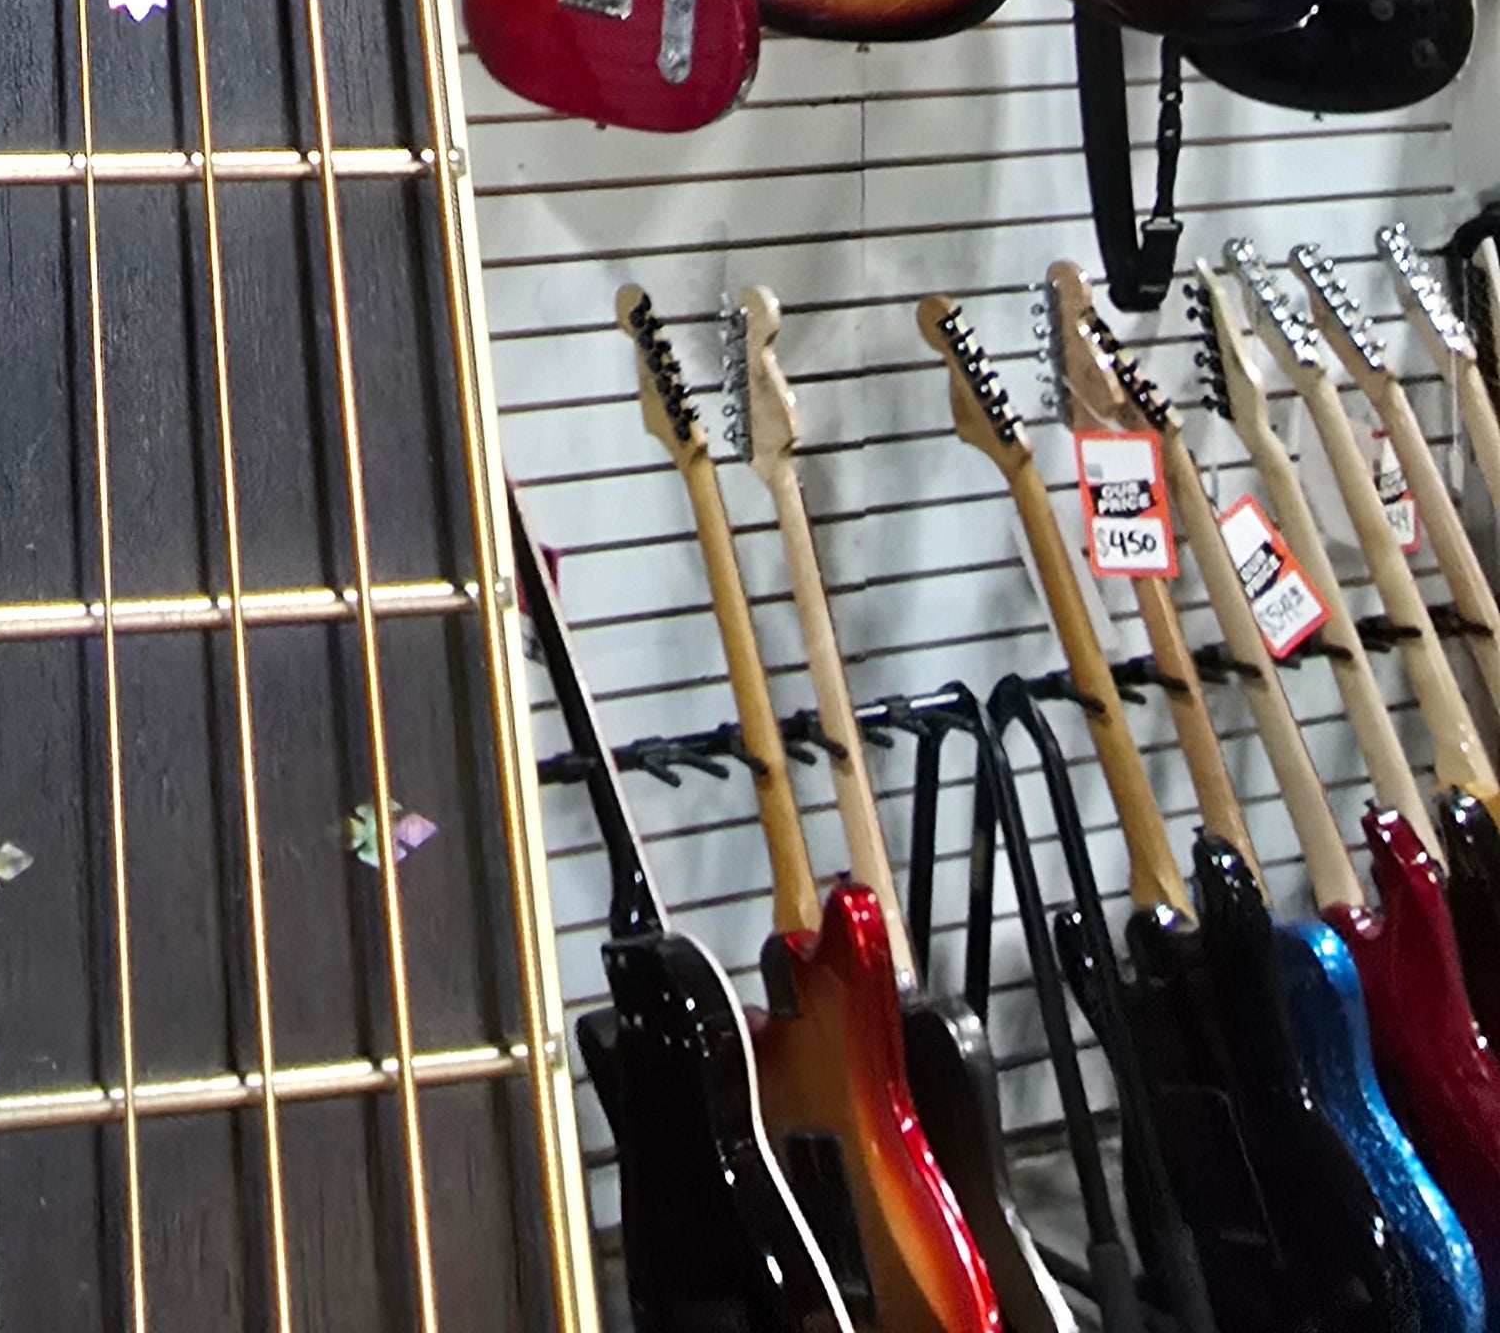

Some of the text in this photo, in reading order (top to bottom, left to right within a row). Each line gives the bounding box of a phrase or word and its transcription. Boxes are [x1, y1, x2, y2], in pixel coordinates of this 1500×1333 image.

[1101, 482, 1140, 500] OUR
[1097, 492, 1150, 514] PRICE
[1096, 527, 1157, 557] $450
